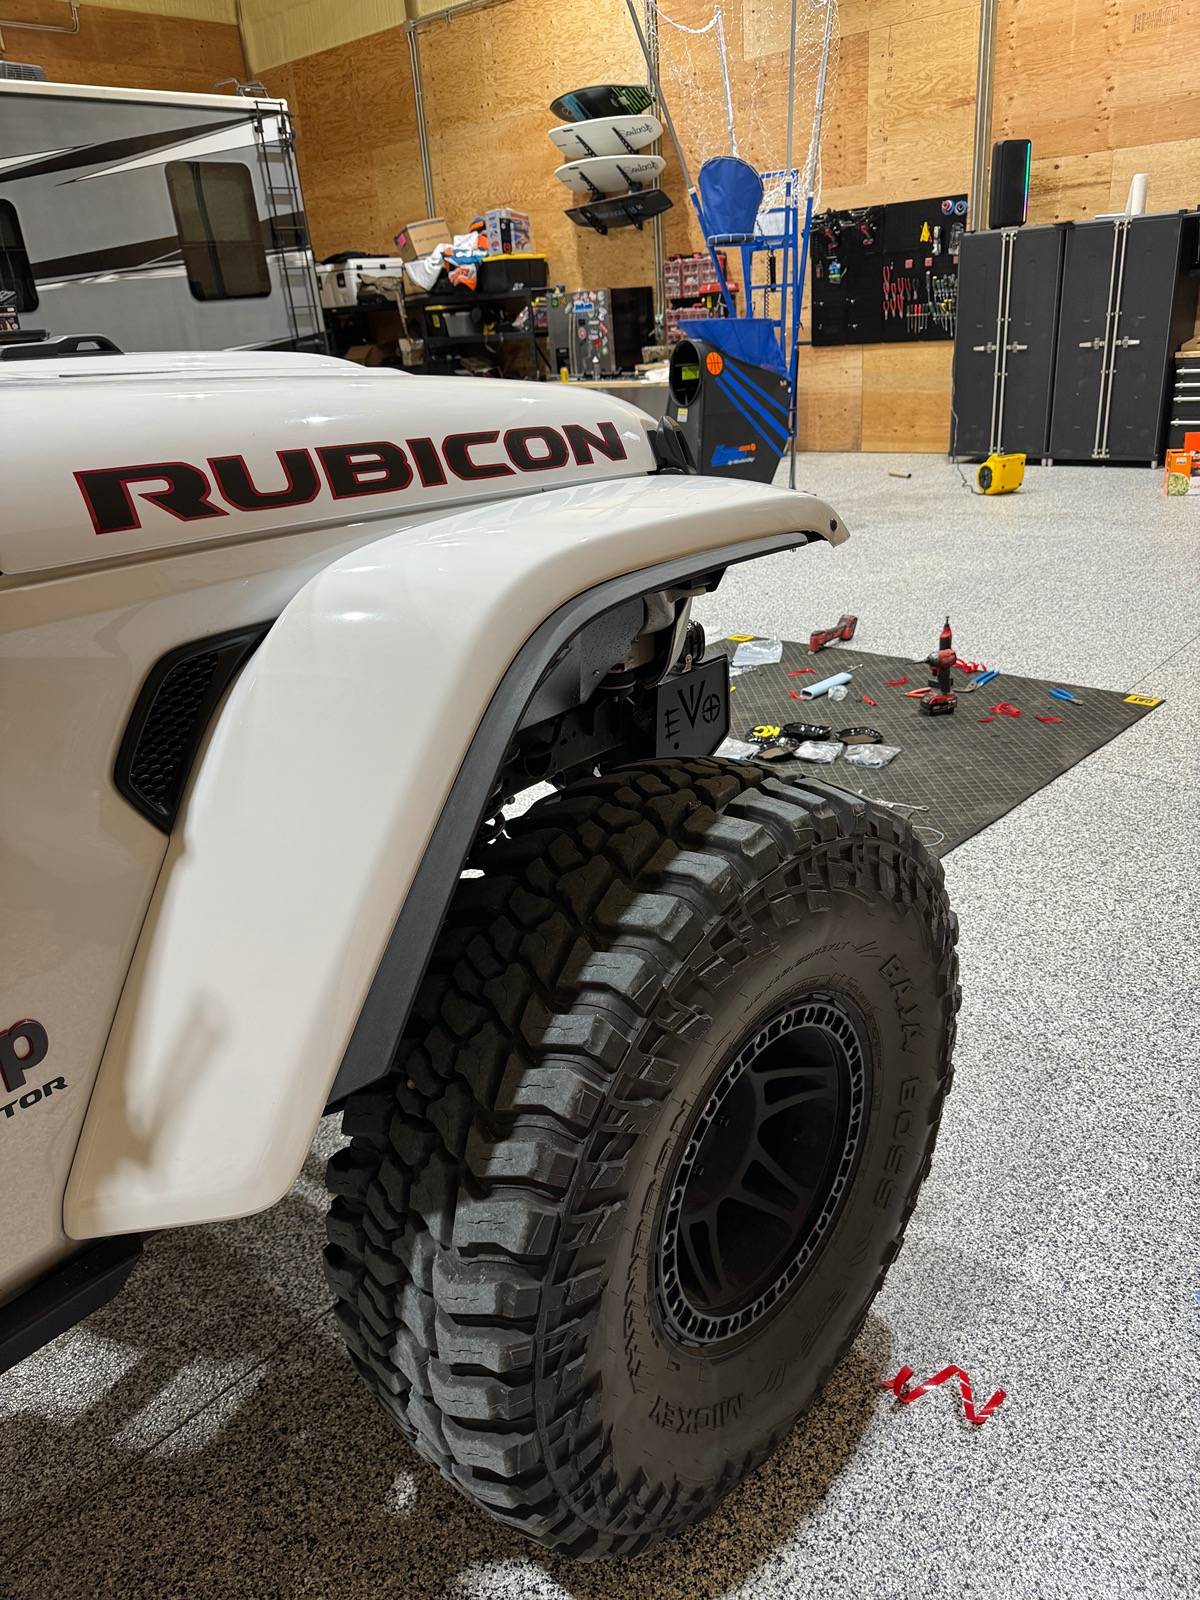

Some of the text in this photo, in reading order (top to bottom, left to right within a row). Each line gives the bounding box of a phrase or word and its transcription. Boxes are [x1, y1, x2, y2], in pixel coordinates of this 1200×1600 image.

[72, 421, 628, 535] RUBICON
[878, 953, 921, 1053] BAJA
[873, 1075, 921, 1209] BOSS
[648, 1391, 744, 1434] MICKEY
